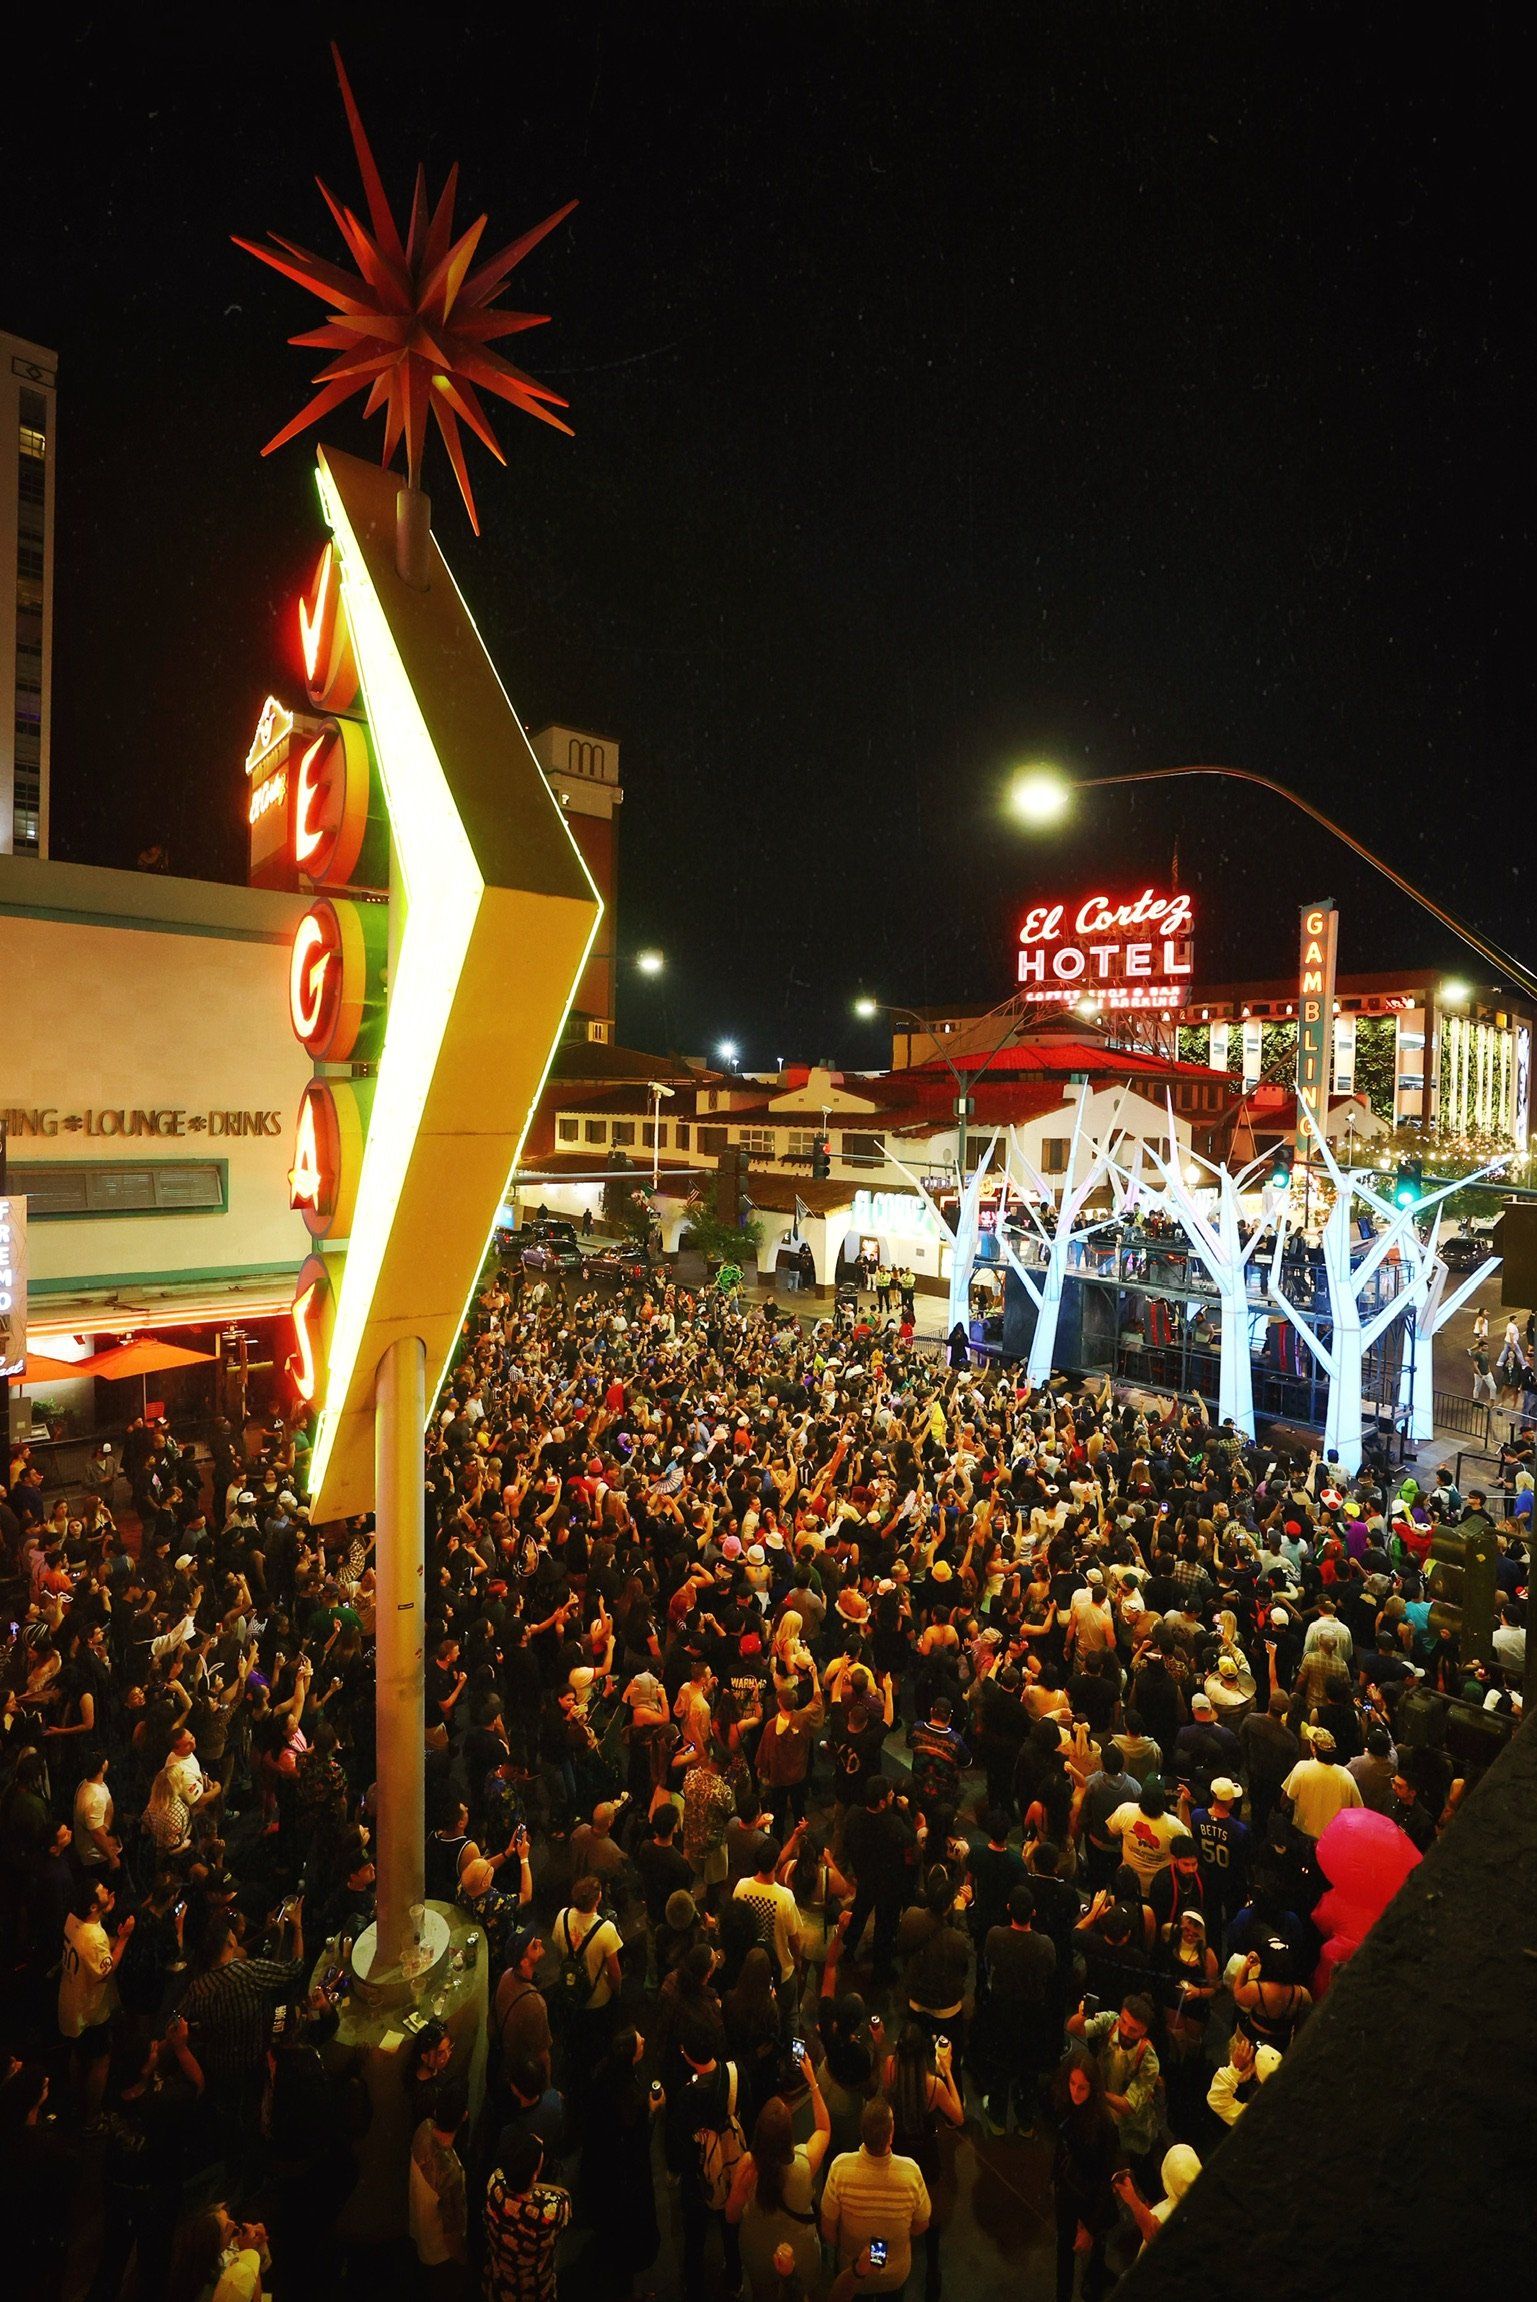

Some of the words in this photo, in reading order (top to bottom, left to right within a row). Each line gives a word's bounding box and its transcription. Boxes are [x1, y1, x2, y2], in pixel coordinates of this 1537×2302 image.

[1019, 905, 1064, 944] El
[1075, 889, 1192, 936] Cortez
[1017, 941, 1191, 982] HOTEL
[1110, 996, 1179, 1008] PARKING
[1150, 986, 1181, 997] BAR
[1299, 911, 1324, 1138] GAMBLING
[85, 1109, 187, 1137] LOUNGE
[207, 1110, 282, 1136] DRINKS
[1200, 1823, 1228, 1841] BETTS
[1201, 1838, 1229, 1868] 50
